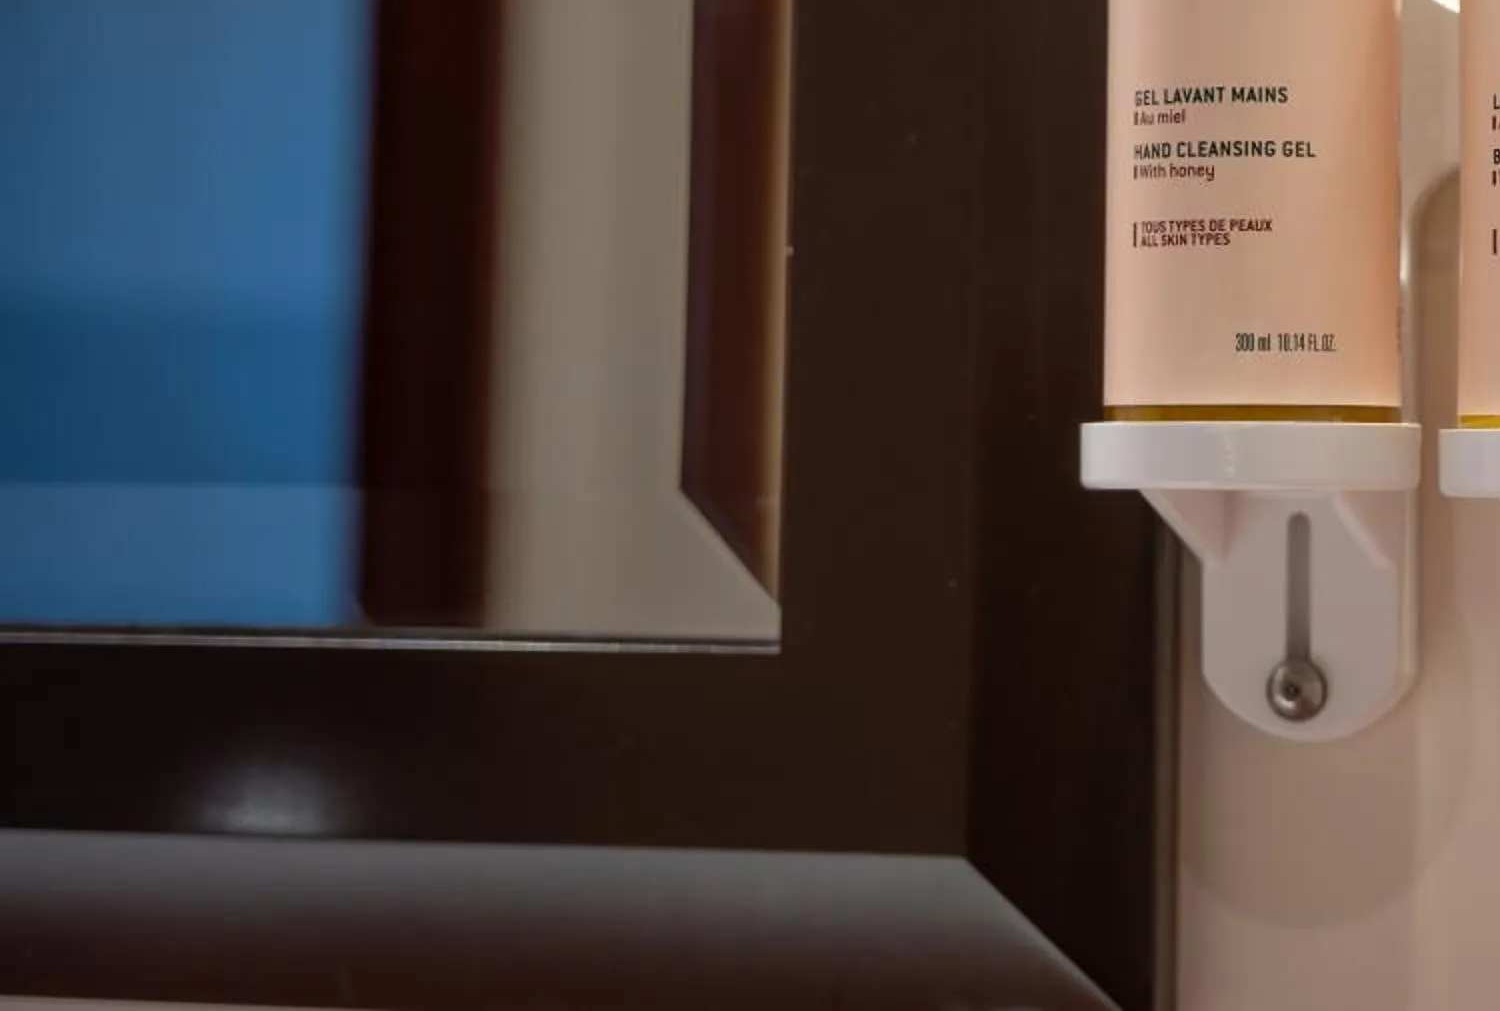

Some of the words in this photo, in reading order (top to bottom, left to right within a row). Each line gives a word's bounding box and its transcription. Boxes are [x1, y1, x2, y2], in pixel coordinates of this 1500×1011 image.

[1135, 90, 1159, 106] GEL
[1163, 87, 1226, 105] LAVANT
[1231, 87, 1288, 104] MAINS
[1140, 112, 1154, 125] Au
[1157, 108, 1185, 124] miel
[1134, 142, 1171, 159] HAND
[1177, 141, 1275, 158] CLEANSING
[1282, 142, 1316, 157] GEL
[1140, 165, 1166, 178] With
[1170, 164, 1215, 181] honey
[1141, 220, 1167, 233] TOUS
[1169, 220, 1205, 232] TYPES
[1209, 219, 1226, 232] DE
[1229, 219, 1272, 232] PEAUX
[1140, 234, 1159, 247] ALL
[1161, 234, 1187, 246] SKIN
[1191, 233, 1231, 245] TYPES
[1236, 333, 1254, 352] 300
[1257, 333, 1271, 351] ml
